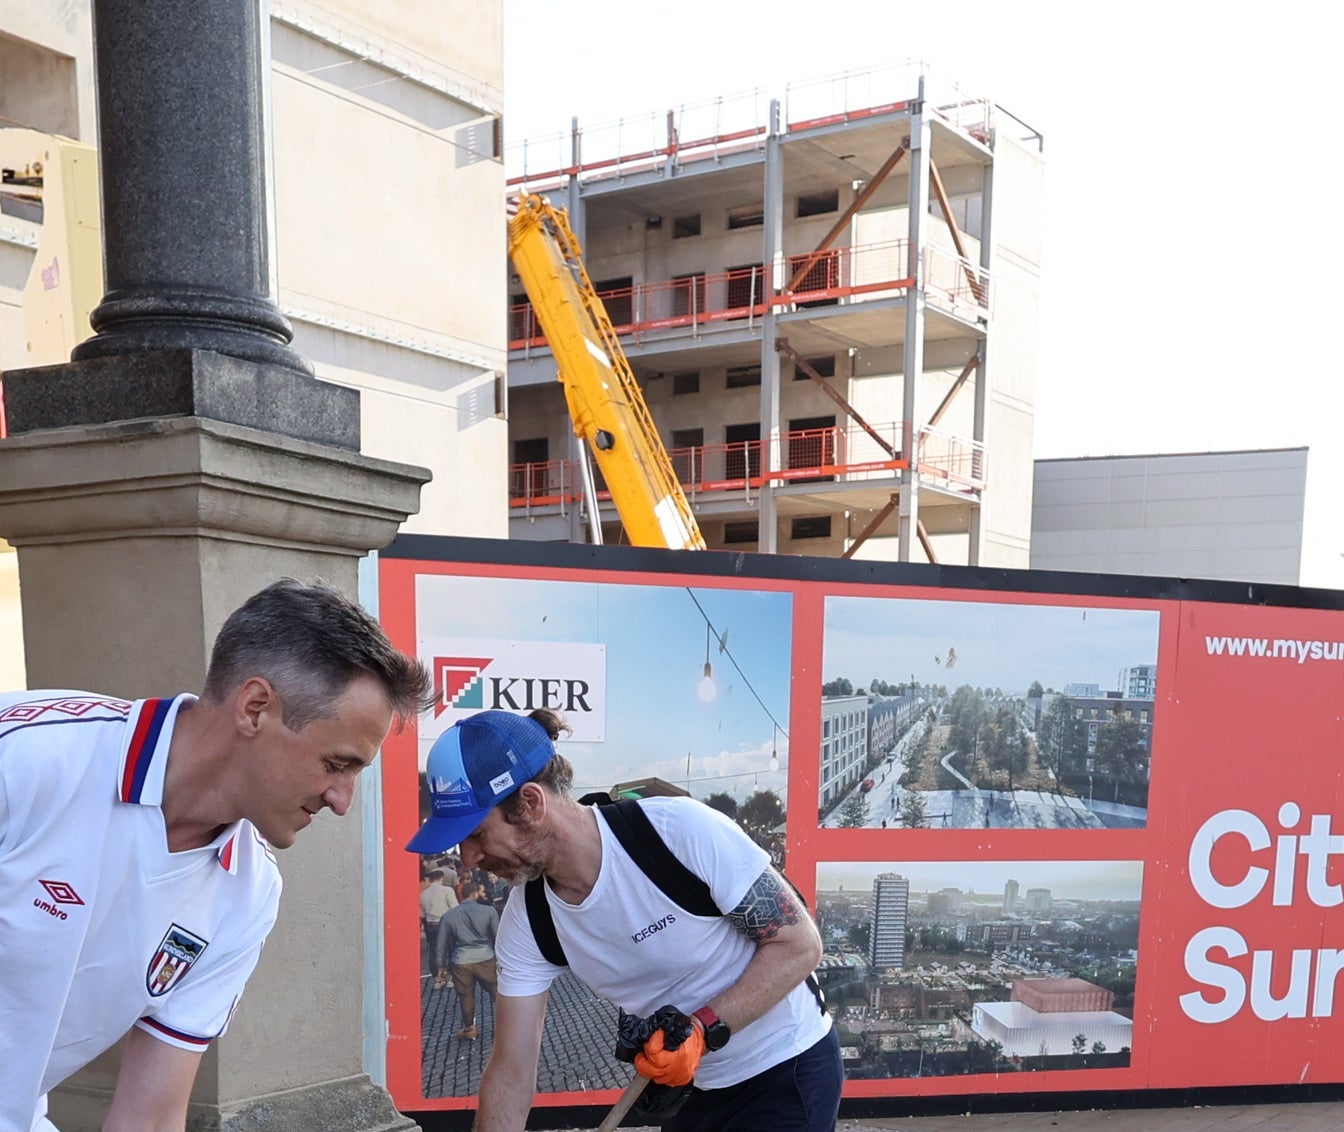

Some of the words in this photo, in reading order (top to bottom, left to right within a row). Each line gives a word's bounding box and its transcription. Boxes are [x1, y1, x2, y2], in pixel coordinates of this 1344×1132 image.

[489, 677, 593, 712] KIER
[33, 898, 68, 921] umbro
[631, 914, 676, 944] ICEGUYS
